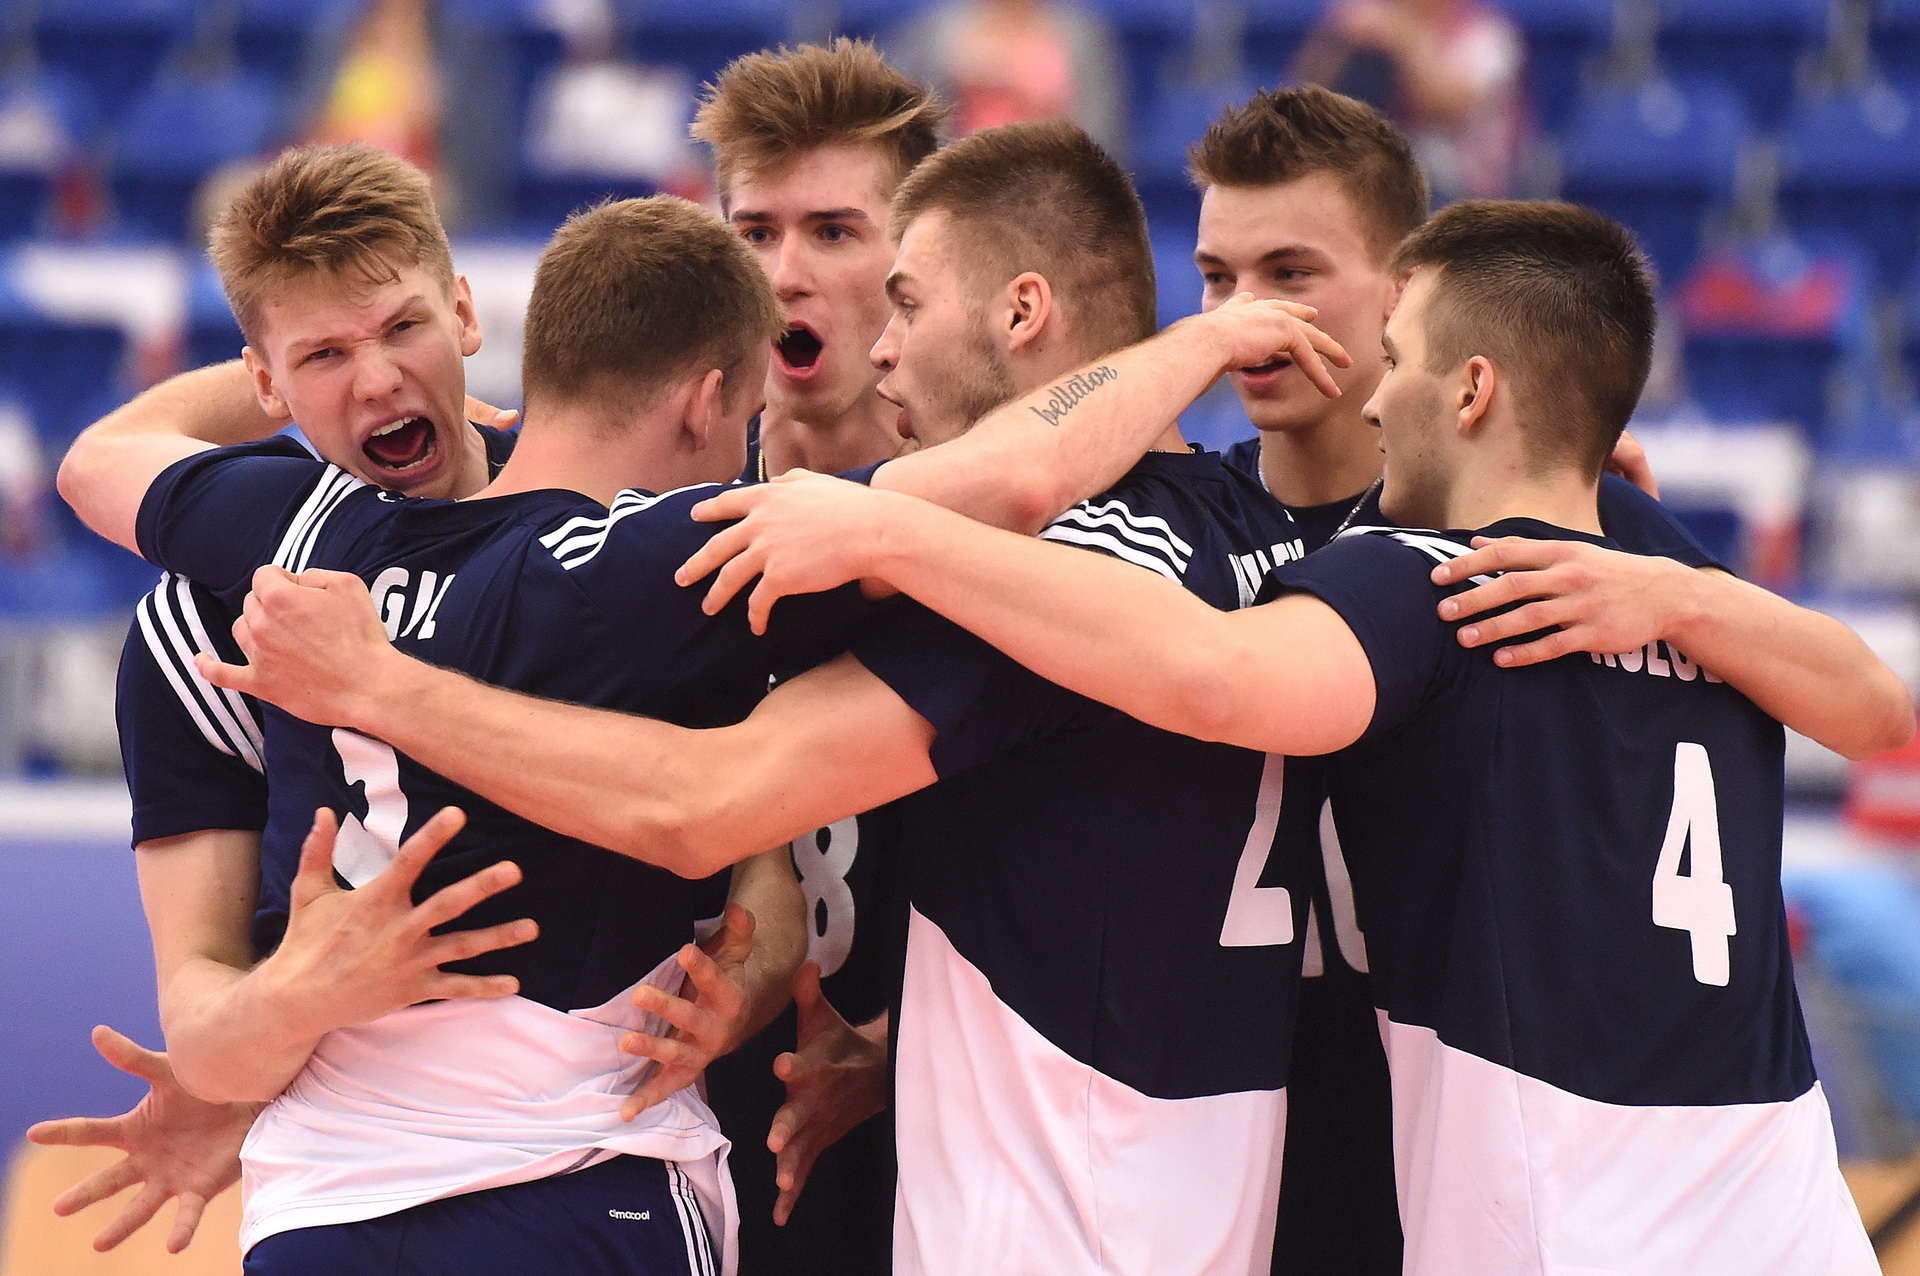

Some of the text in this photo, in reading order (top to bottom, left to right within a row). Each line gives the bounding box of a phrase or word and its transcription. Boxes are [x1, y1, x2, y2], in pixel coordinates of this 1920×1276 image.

[1029, 366, 1118, 427] bellator
[792, 815, 859, 978] 8
[1652, 742, 1737, 987] 4
